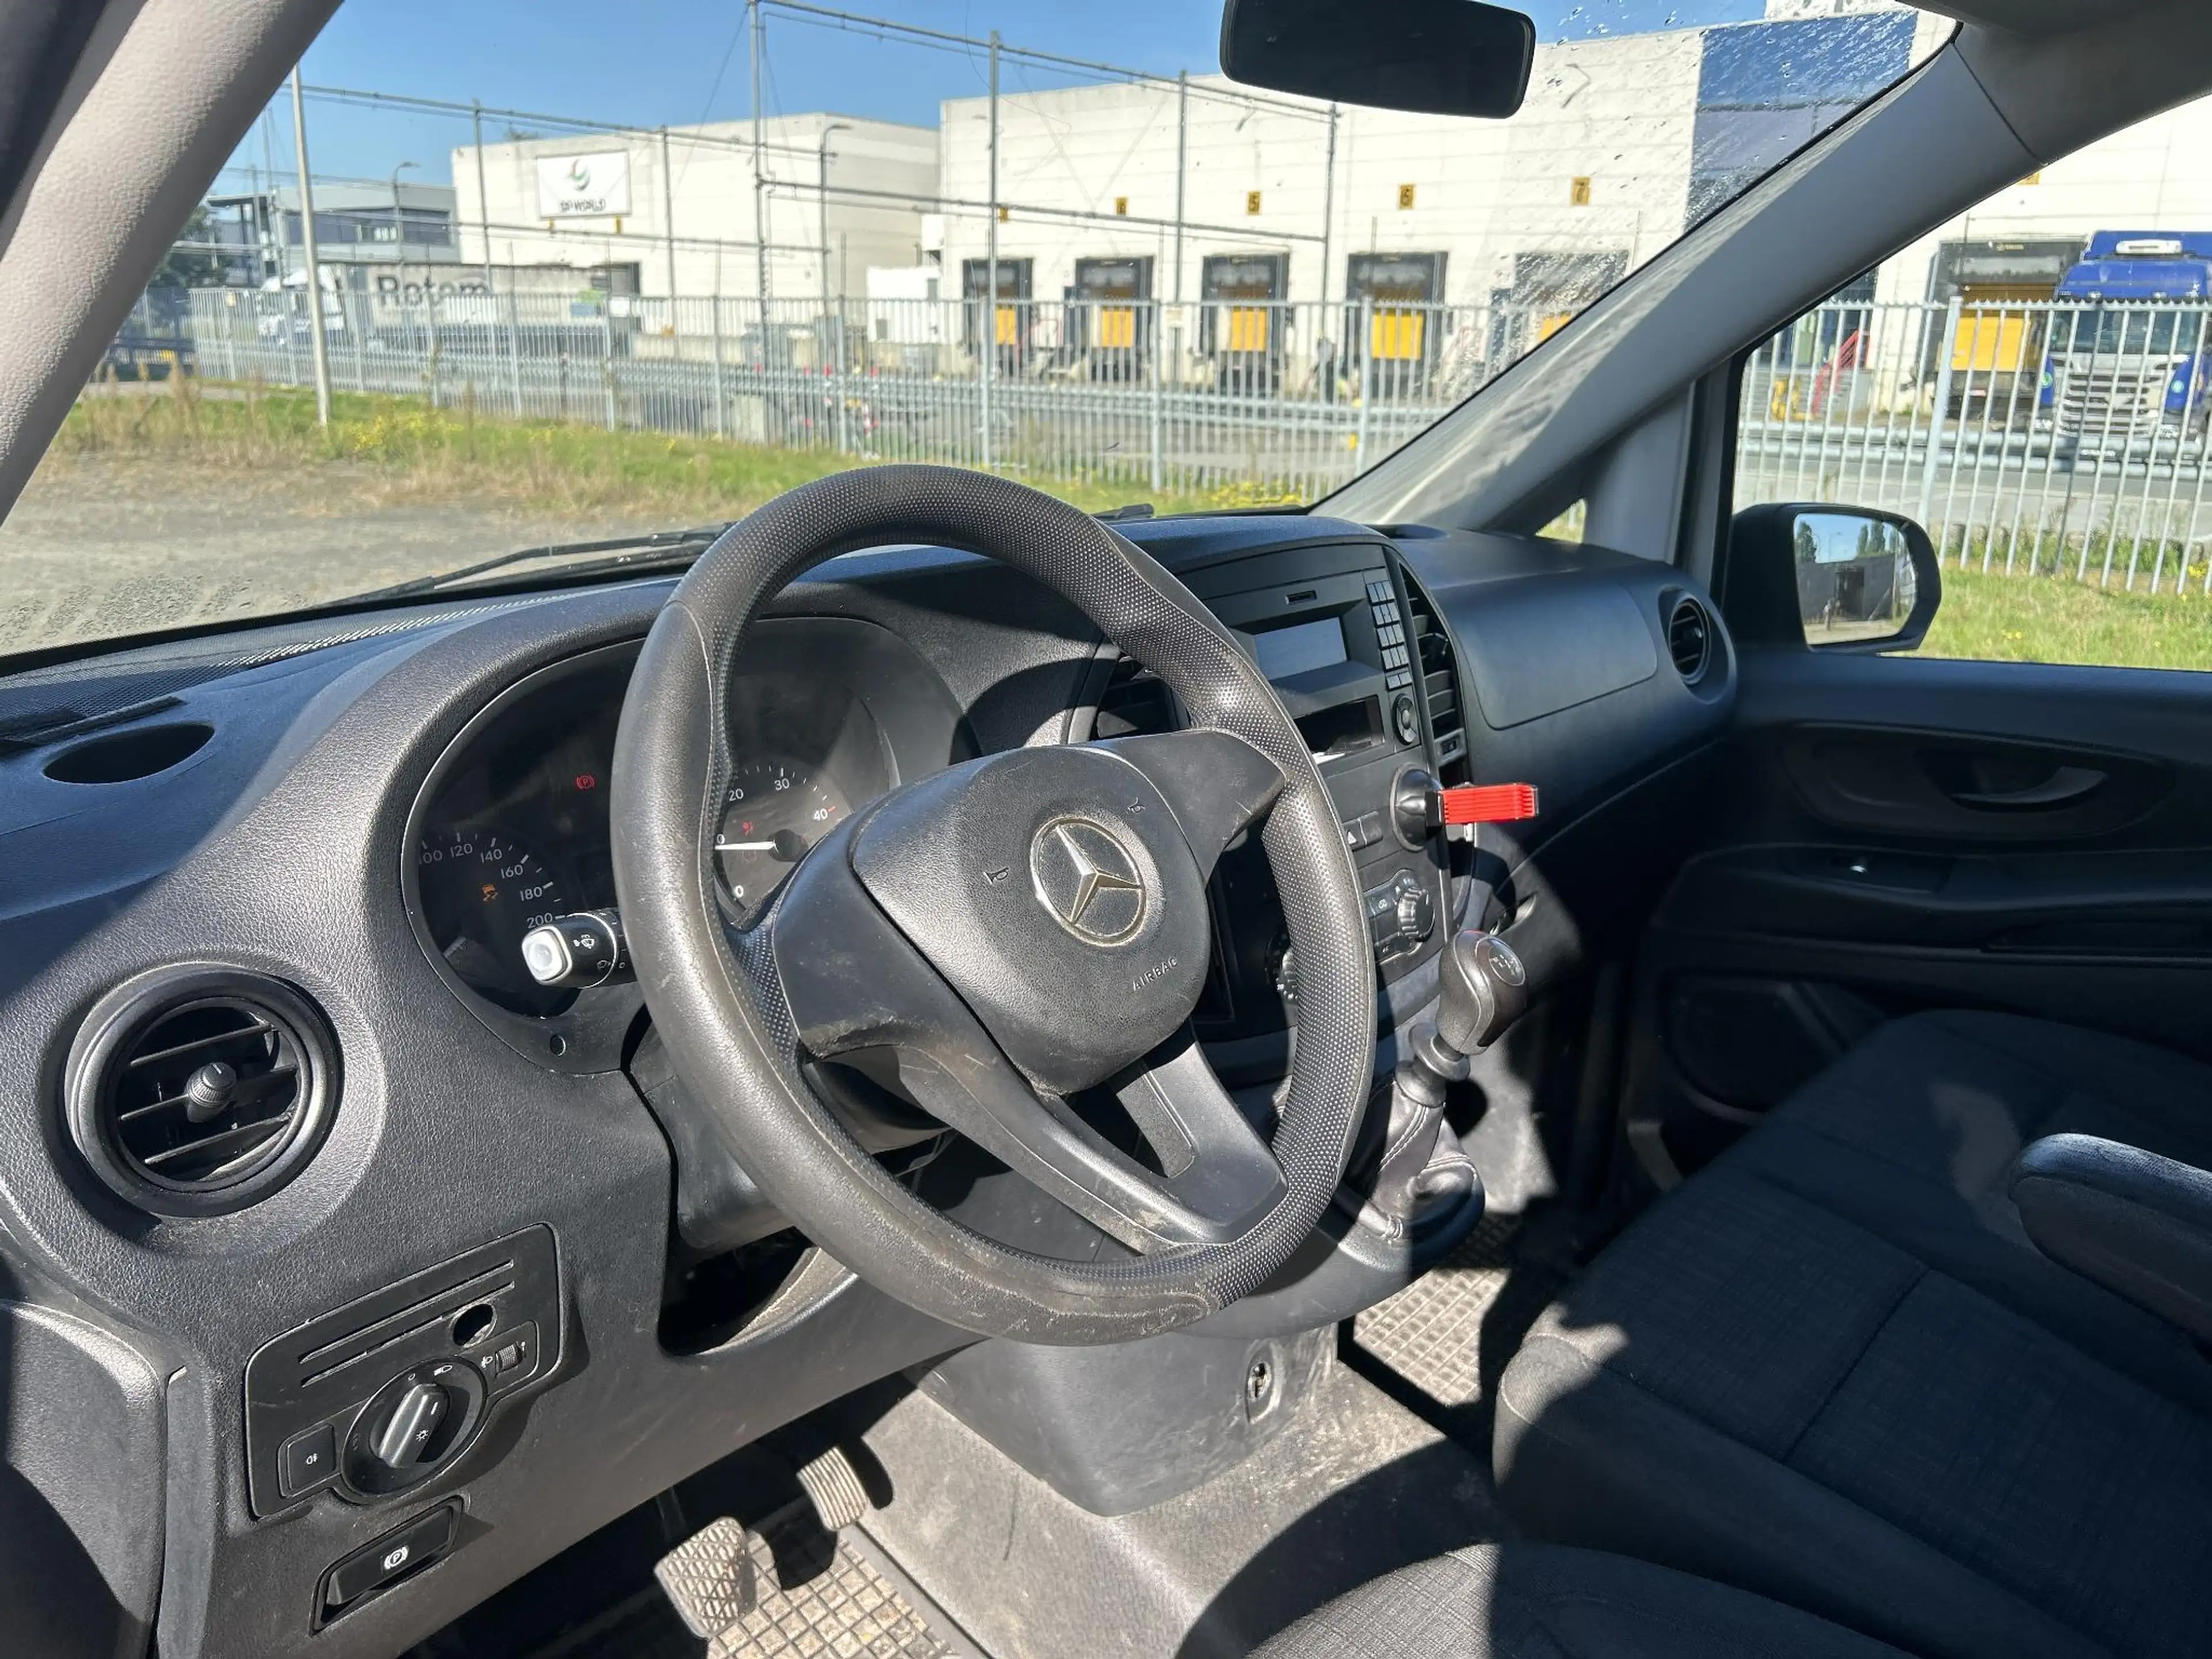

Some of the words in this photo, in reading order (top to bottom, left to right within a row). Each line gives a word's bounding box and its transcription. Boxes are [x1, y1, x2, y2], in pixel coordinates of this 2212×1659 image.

[774, 778, 790, 790] 30
[729, 788, 744, 801] 20
[813, 808, 828, 821] 40
[717, 834, 725, 844] 0
[450, 843, 473, 858] 120
[480, 849, 502, 863] 140
[501, 864, 524, 878] 160
[520, 887, 543, 902] 180
[734, 885, 744, 897] 0
[527, 912, 553, 929] 200
